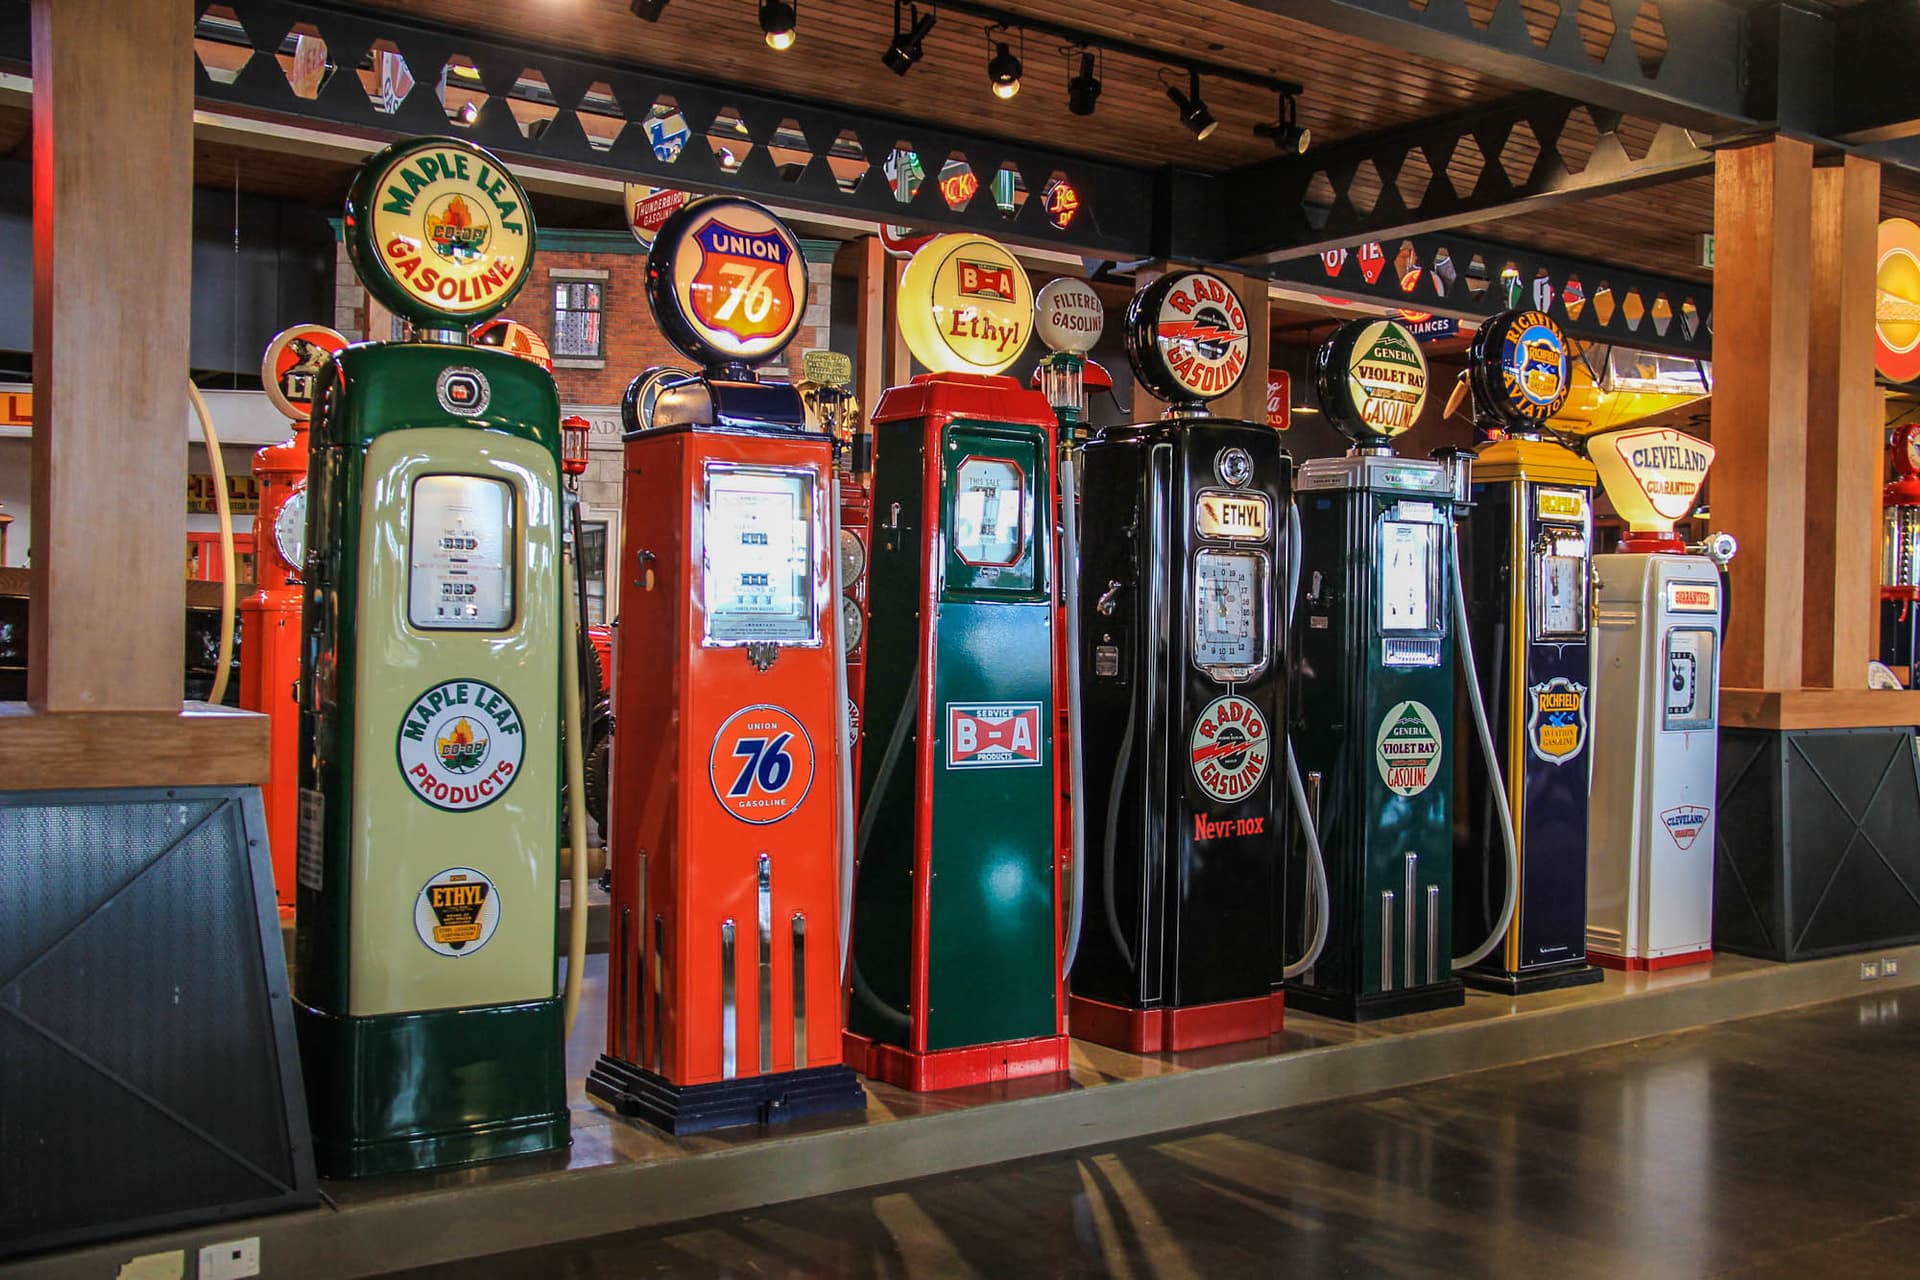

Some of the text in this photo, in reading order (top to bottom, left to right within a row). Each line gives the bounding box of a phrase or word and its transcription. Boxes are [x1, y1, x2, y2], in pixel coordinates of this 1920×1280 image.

[383, 152, 523, 236] MAPLE LEAF
[636, 191, 682, 220] THUNDERBIRD
[434, 225, 484, 241] CO-OP
[712, 234, 781, 262] UNION
[387, 237, 514, 303] GASOLINE
[713, 262, 776, 323] 76
[1054, 293, 1100, 311] FILTERED
[1169, 278, 1244, 331] RADIO
[950, 310, 1019, 352] Ethyl
[1409, 319, 1449, 335] LIANCES
[1506, 312, 1568, 356] RICHFIELD
[1167, 344, 1245, 392] GASOLINE
[1374, 347, 1417, 363] GENERAL
[1358, 366, 1425, 388] VIOLET RAY
[1503, 371, 1567, 418] AVIATION
[1362, 399, 1415, 428] GASOLINE
[1632, 446, 1706, 472] CLEVELAND
[1647, 481, 1696, 496] GUARANTEED
[1223, 503, 1261, 527] ETHYL
[403, 684, 520, 742] MAPLE LEAF
[1540, 693, 1580, 712] RICHFIELD
[1199, 702, 1262, 739] RADIO
[1394, 727, 1427, 736] GENERAL
[441, 743, 483, 755] CO-OP
[1383, 743, 1436, 755] VIOLET RAY
[726, 731, 795, 798] 76
[1200, 751, 1264, 796] GASOLINE
[1387, 767, 1427, 787] GASOLINE
[409, 760, 514, 804] PRODUCTS
[739, 799, 787, 808] GASOLINE
[1194, 813, 1265, 842] Nevr-nox
[1667, 814, 1704, 827] CLEVELAND
[432, 886, 484, 908] ETHYL
